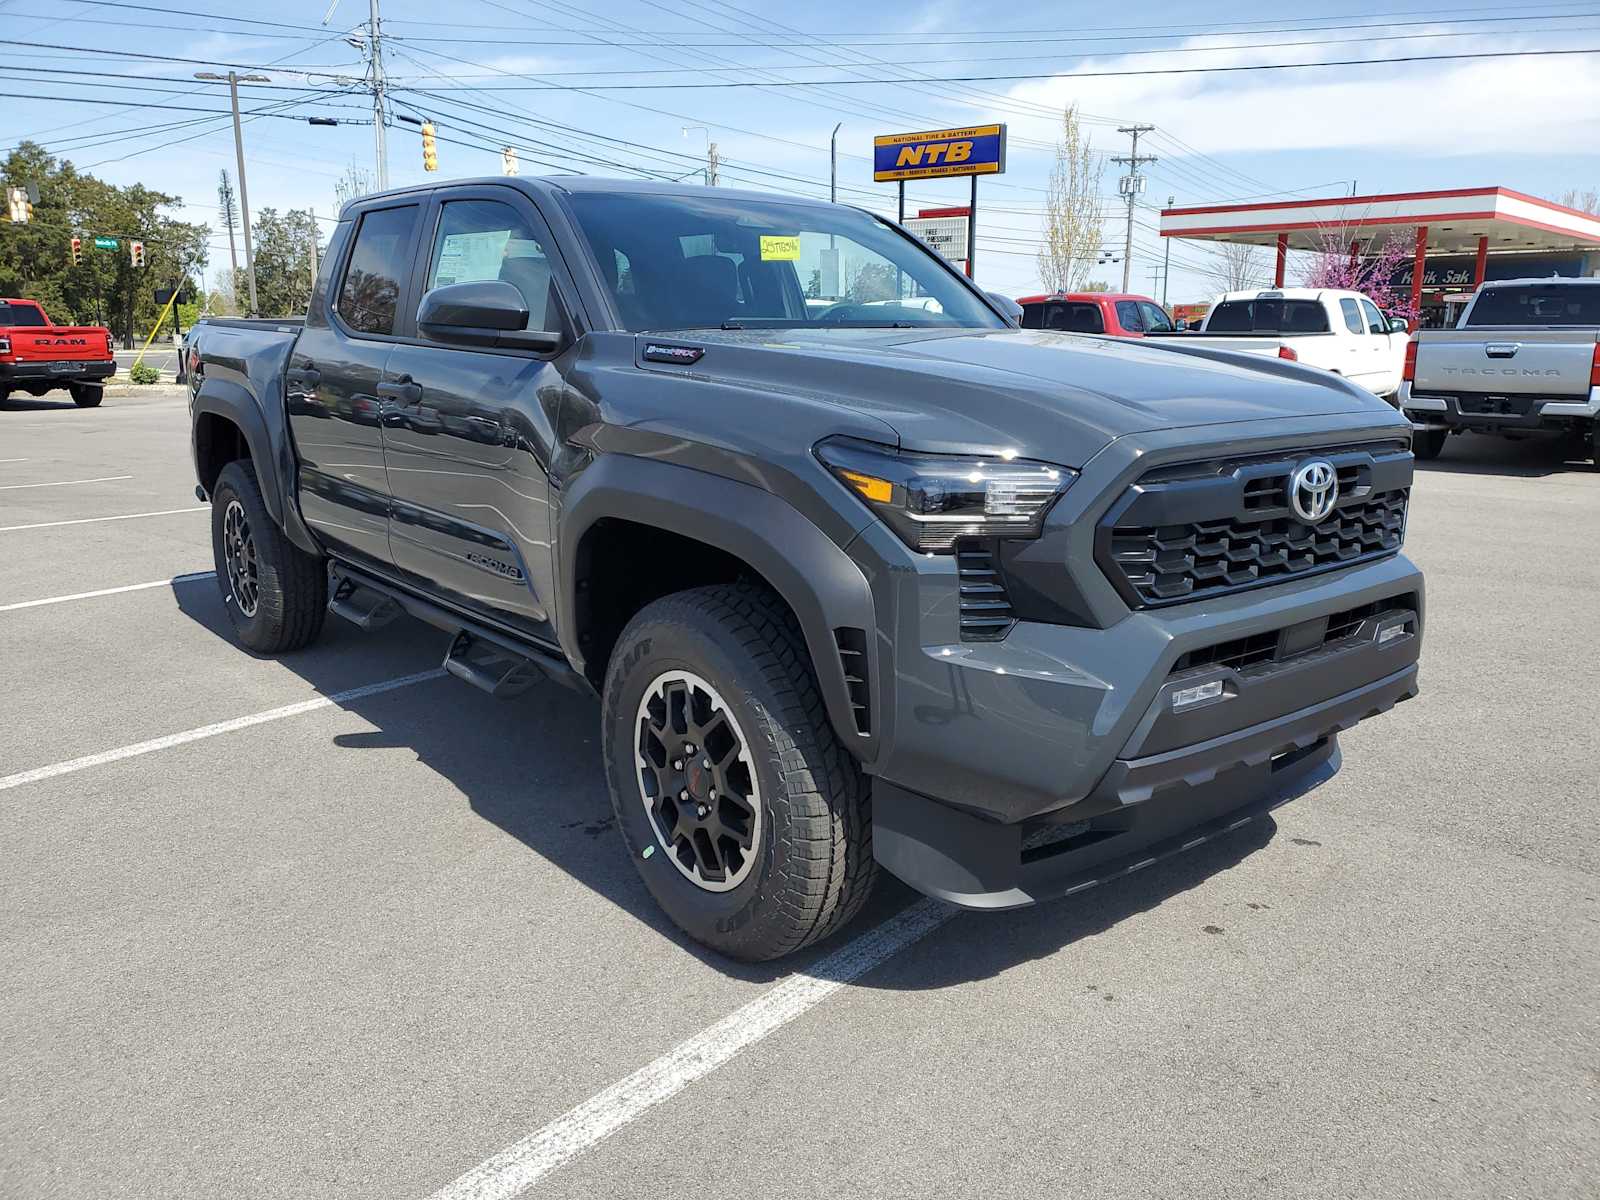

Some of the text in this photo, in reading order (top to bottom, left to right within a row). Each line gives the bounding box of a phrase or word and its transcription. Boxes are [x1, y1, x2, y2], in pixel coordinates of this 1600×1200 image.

[893, 135, 923, 143] NATIONAL
[948, 130, 977, 138] BATTERY
[896, 141, 973, 166] NTB
[1401, 270, 1469, 284] Kik Sak
[1442, 367, 1561, 377] TACOMA
